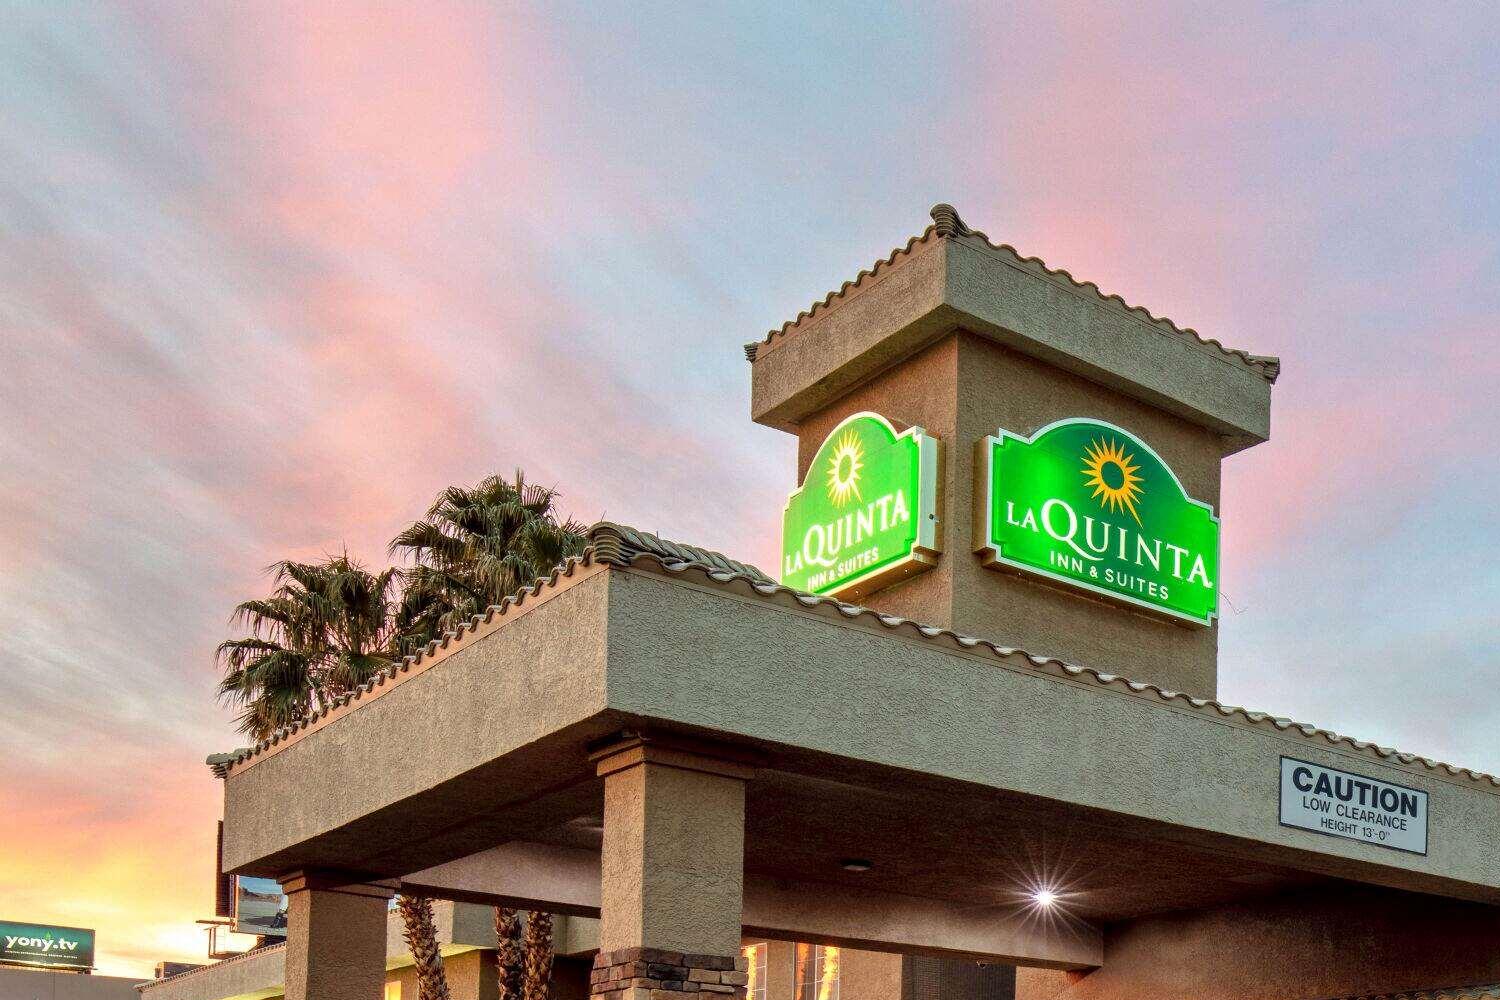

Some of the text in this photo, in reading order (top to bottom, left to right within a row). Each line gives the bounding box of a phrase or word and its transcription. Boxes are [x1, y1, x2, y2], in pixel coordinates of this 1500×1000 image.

[785, 489, 910, 576] LA QUINTA
[1006, 498, 1214, 589] LA QUINTA
[807, 571, 827, 592] INN
[838, 546, 879, 578] SUITES
[1050, 551, 1169, 600] INN & SUITES
[1292, 766, 1418, 818] CAUTION
[1302, 796, 1408, 831] LOW CLEARANCE
[1320, 817, 1358, 835] HEIGHT
[5, 935, 79, 952] yony.tv
